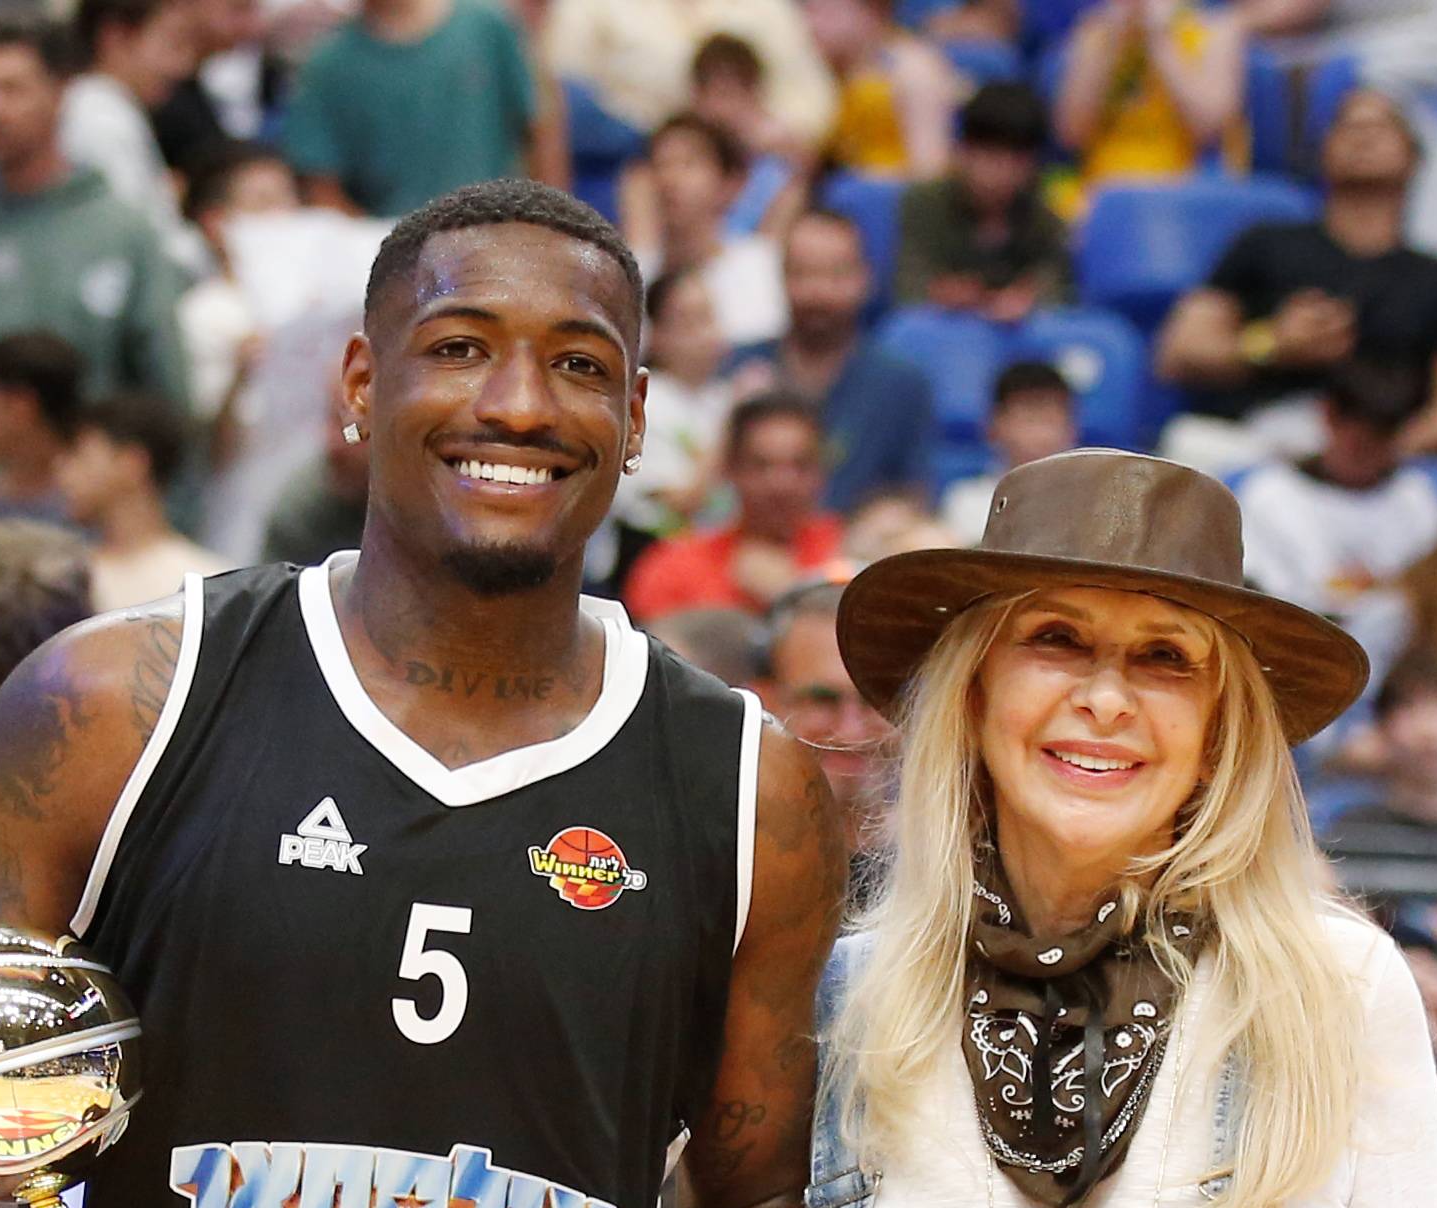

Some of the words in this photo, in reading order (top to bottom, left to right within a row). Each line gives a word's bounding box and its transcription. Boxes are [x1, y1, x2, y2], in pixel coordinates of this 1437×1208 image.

[278, 834, 368, 875] PEAK
[533, 850, 620, 883] Winner
[392, 902, 472, 1044] 5
